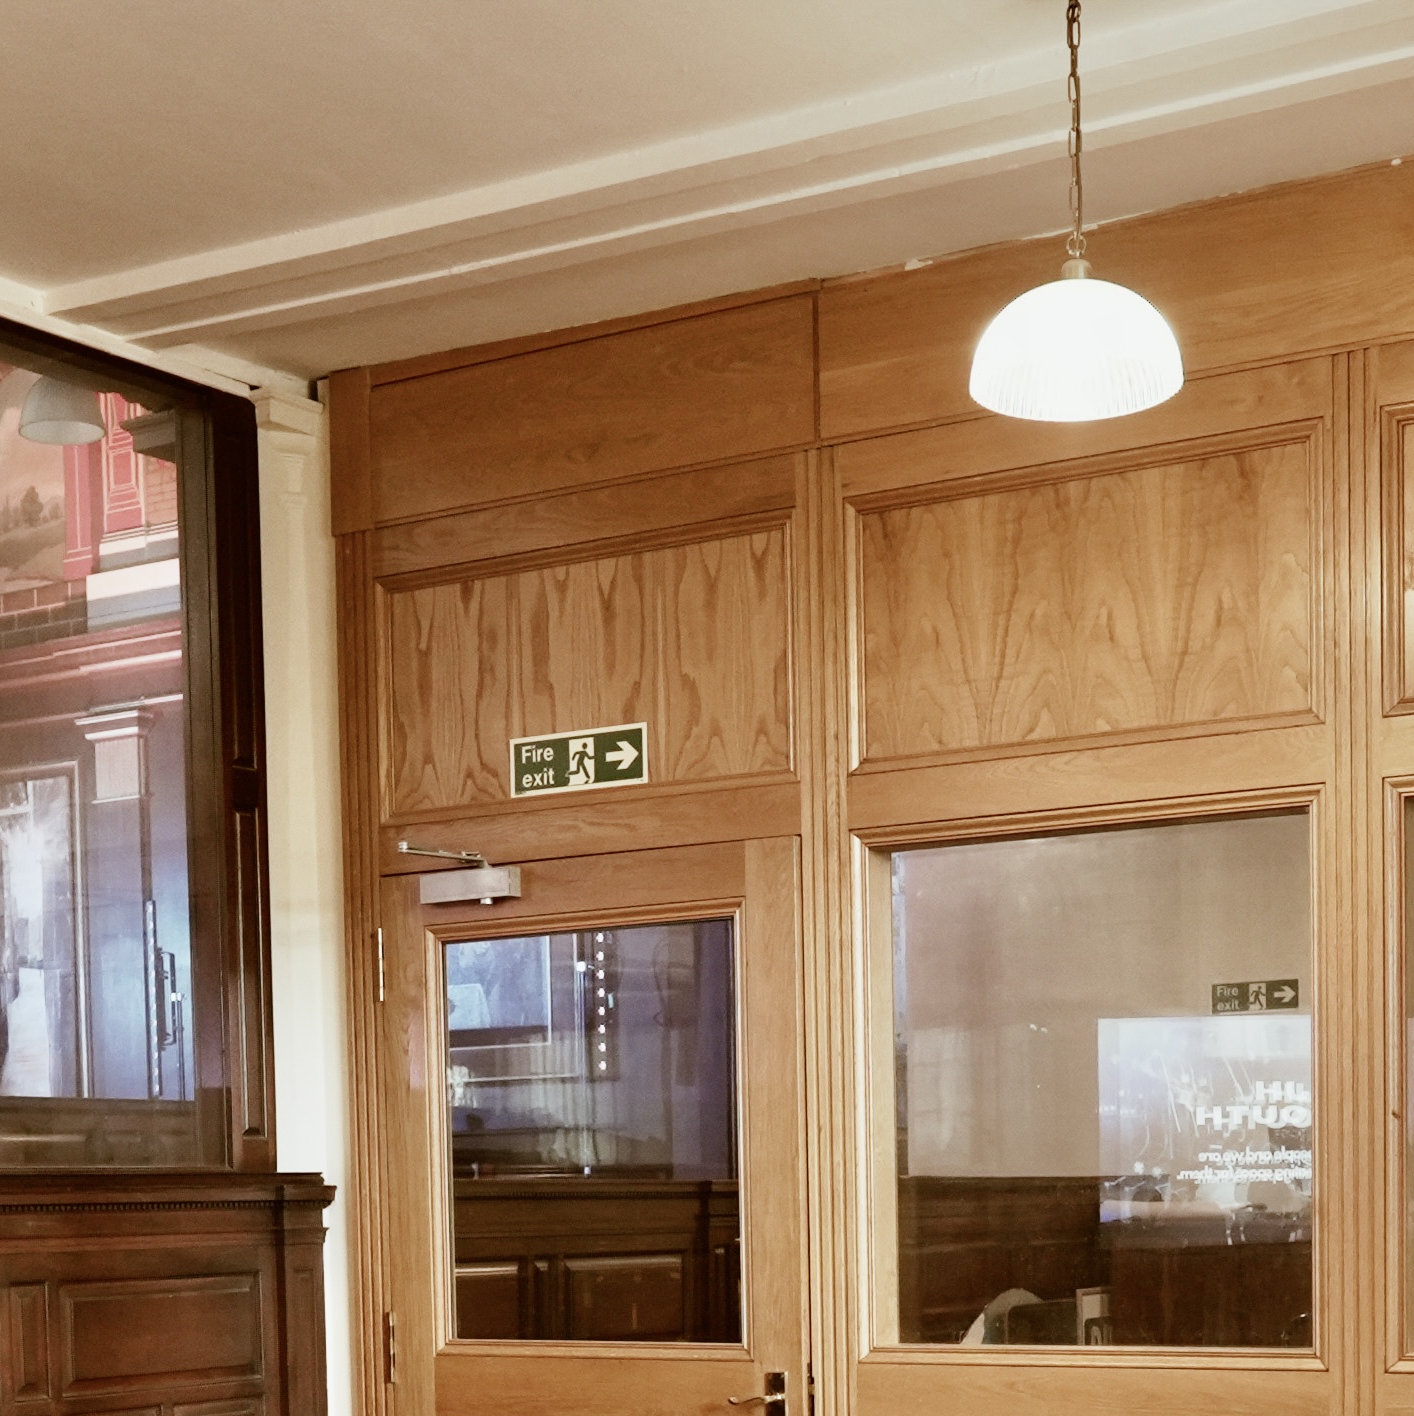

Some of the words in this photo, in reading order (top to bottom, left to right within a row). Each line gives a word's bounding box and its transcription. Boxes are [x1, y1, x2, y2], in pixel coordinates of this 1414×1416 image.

[521, 744, 554, 764] Fire
[522, 768, 555, 788] exit
[1216, 985, 1239, 997] Fire
[1216, 1000, 1240, 1011] exit
